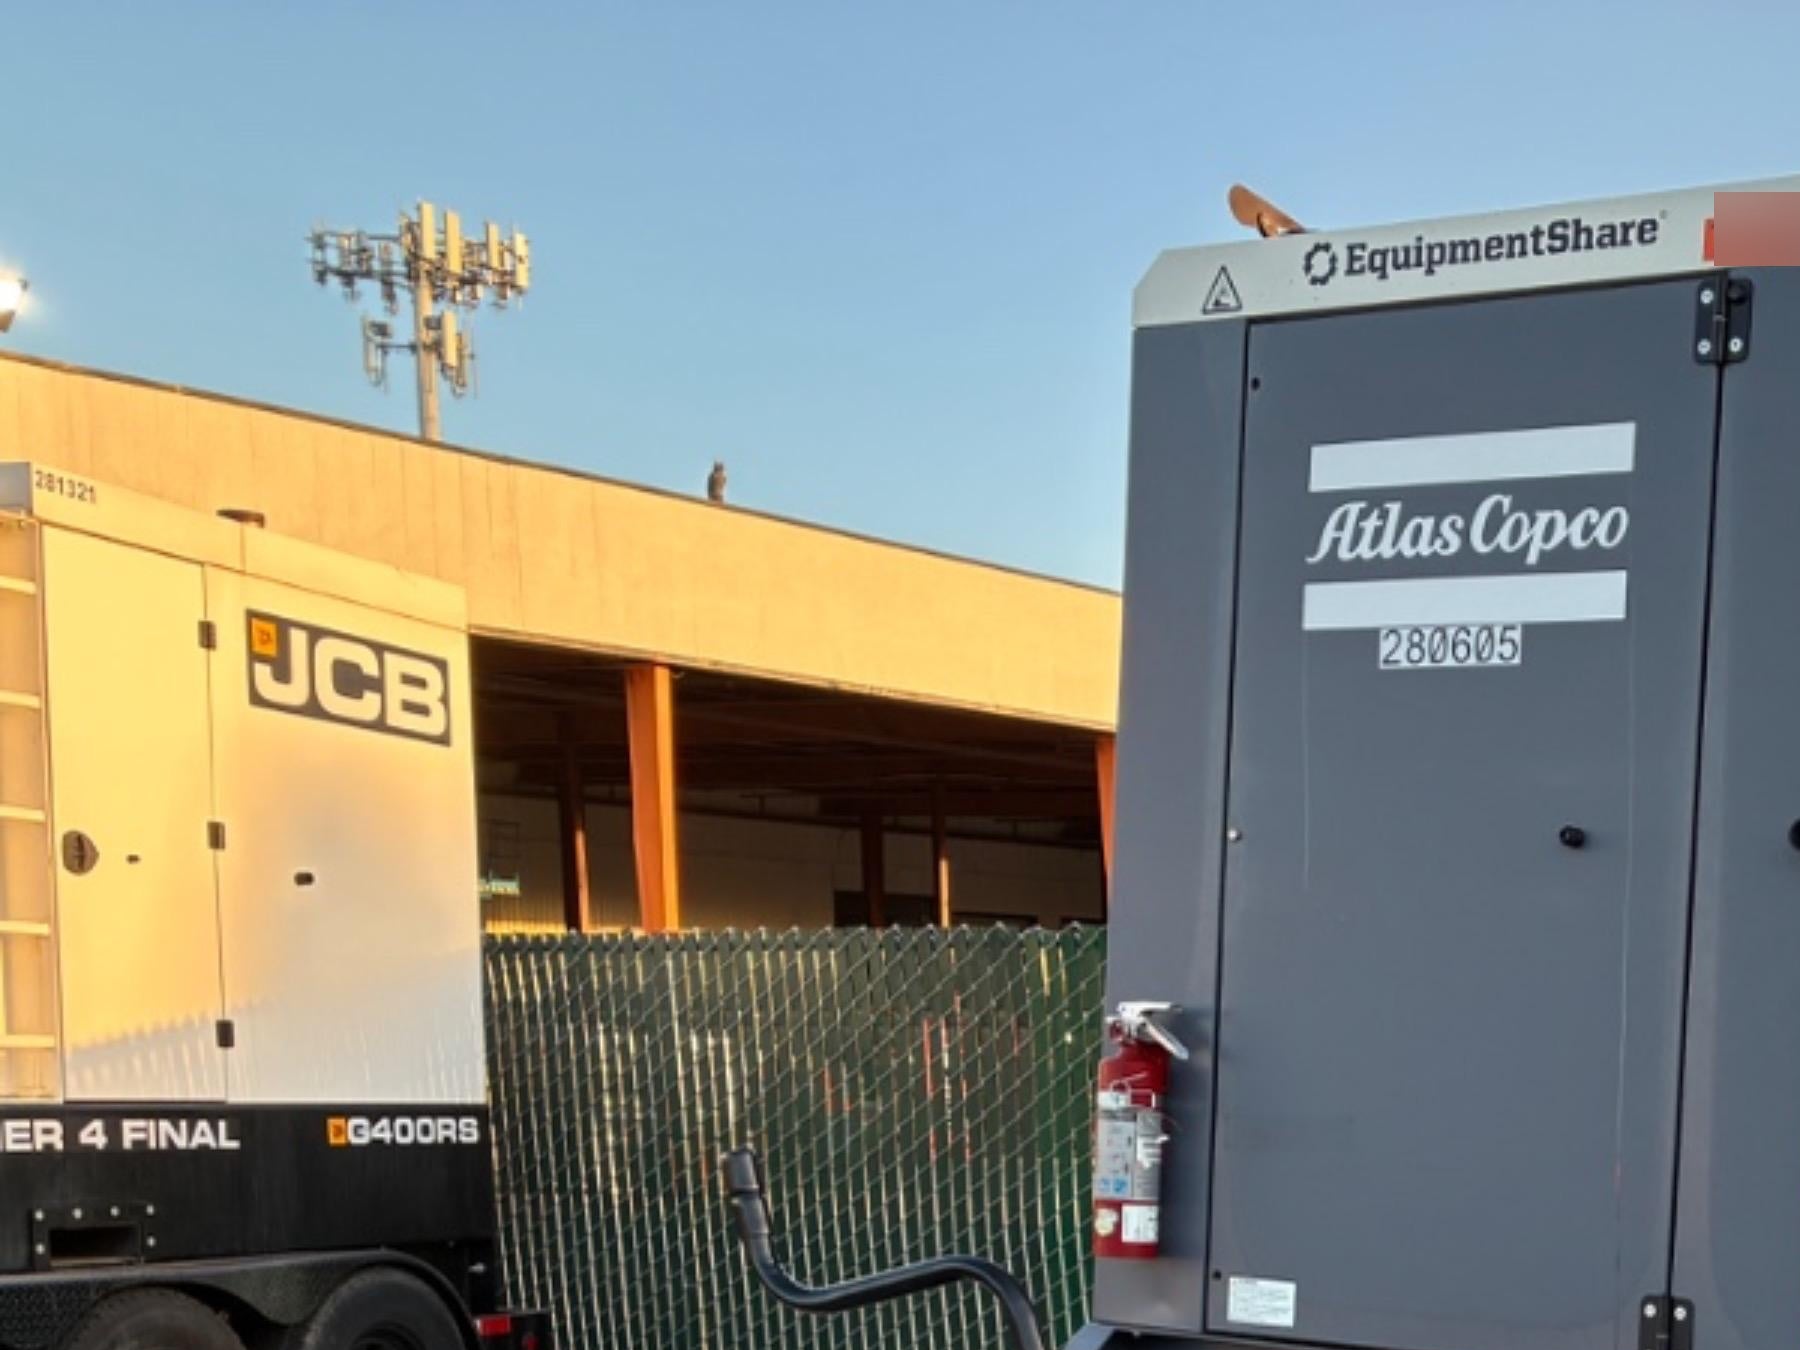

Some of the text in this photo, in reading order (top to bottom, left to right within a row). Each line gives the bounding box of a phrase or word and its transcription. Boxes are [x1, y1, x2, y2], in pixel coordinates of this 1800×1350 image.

[1343, 214, 1660, 277] EquipmentShare
[1305, 494, 1630, 565] Atlas Copco
[1382, 626, 1520, 666] 280605
[252, 626, 449, 738] JCB
[78, 1119, 108, 1150] 4
[122, 1119, 241, 1150] FINAL
